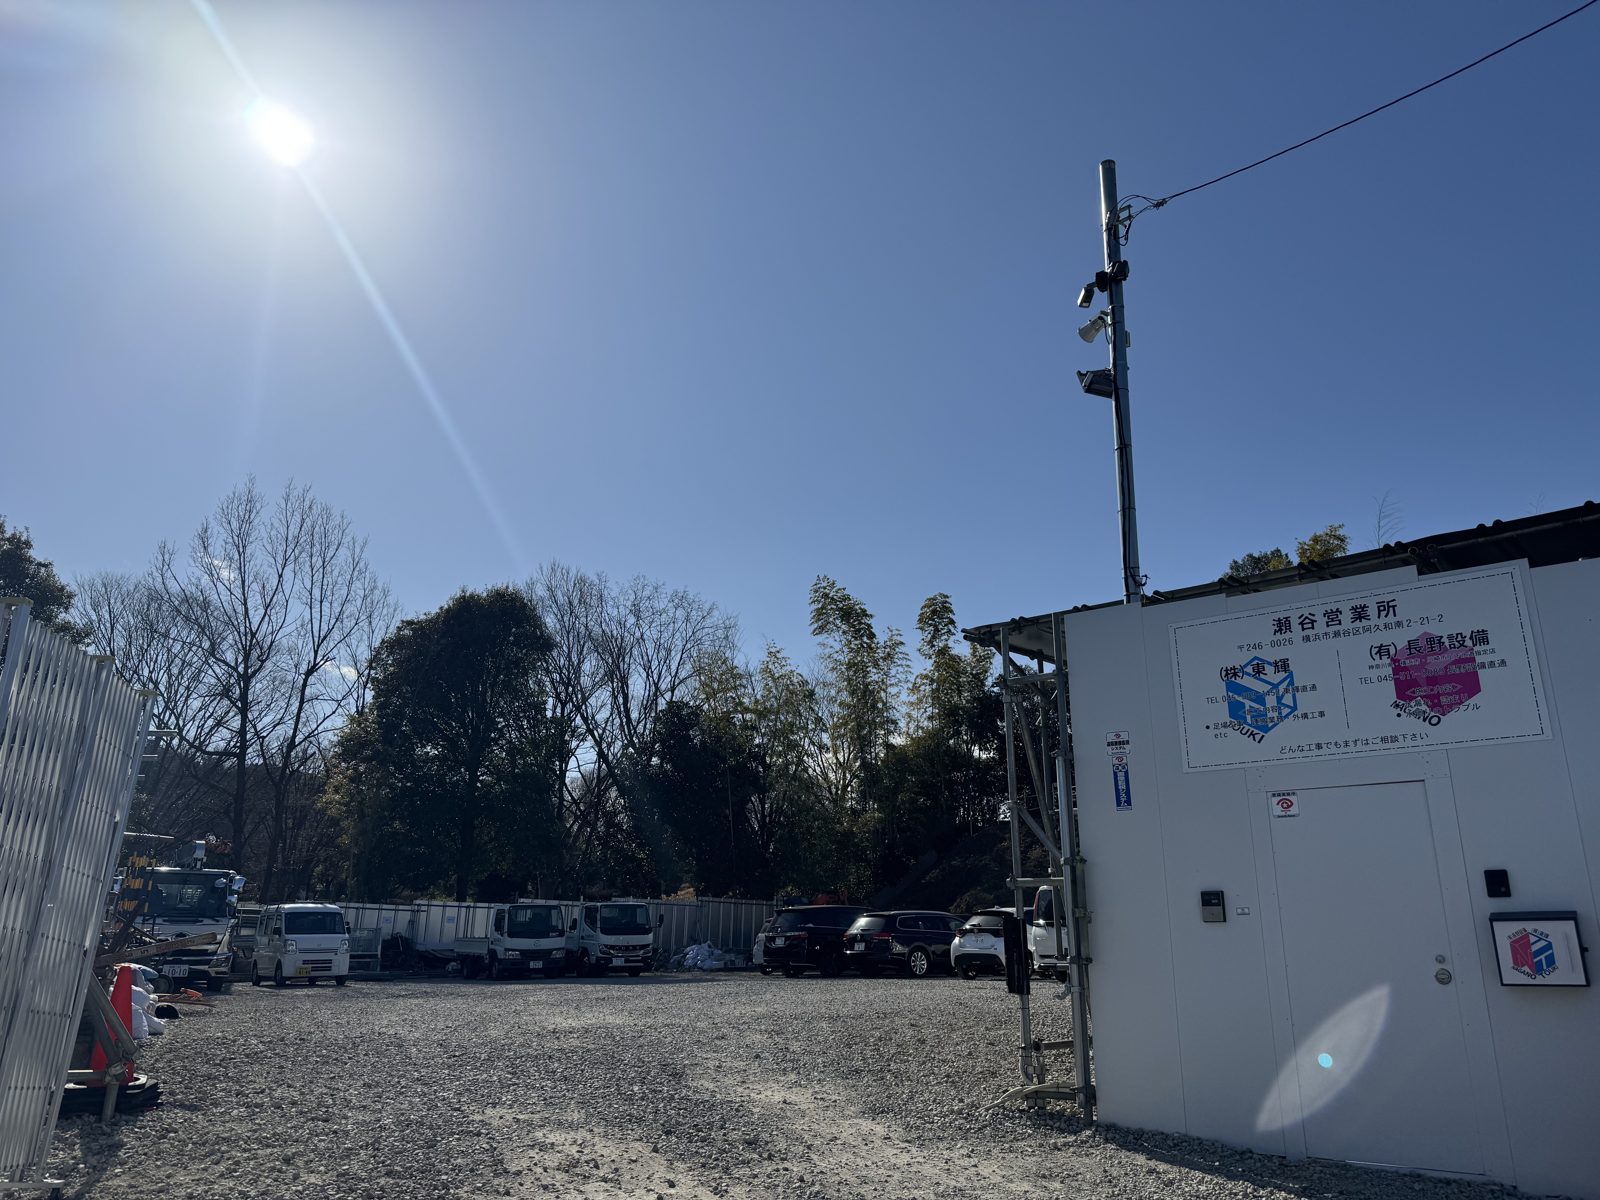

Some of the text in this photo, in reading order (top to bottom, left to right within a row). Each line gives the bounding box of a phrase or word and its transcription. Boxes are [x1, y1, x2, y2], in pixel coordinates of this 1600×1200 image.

[1272, 599, 1398, 636] 瀬谷営業所
[1358, 677, 1374, 685] TEL
[1280, 732, 1429, 755] どんな工事でもまずはご相談下さい
